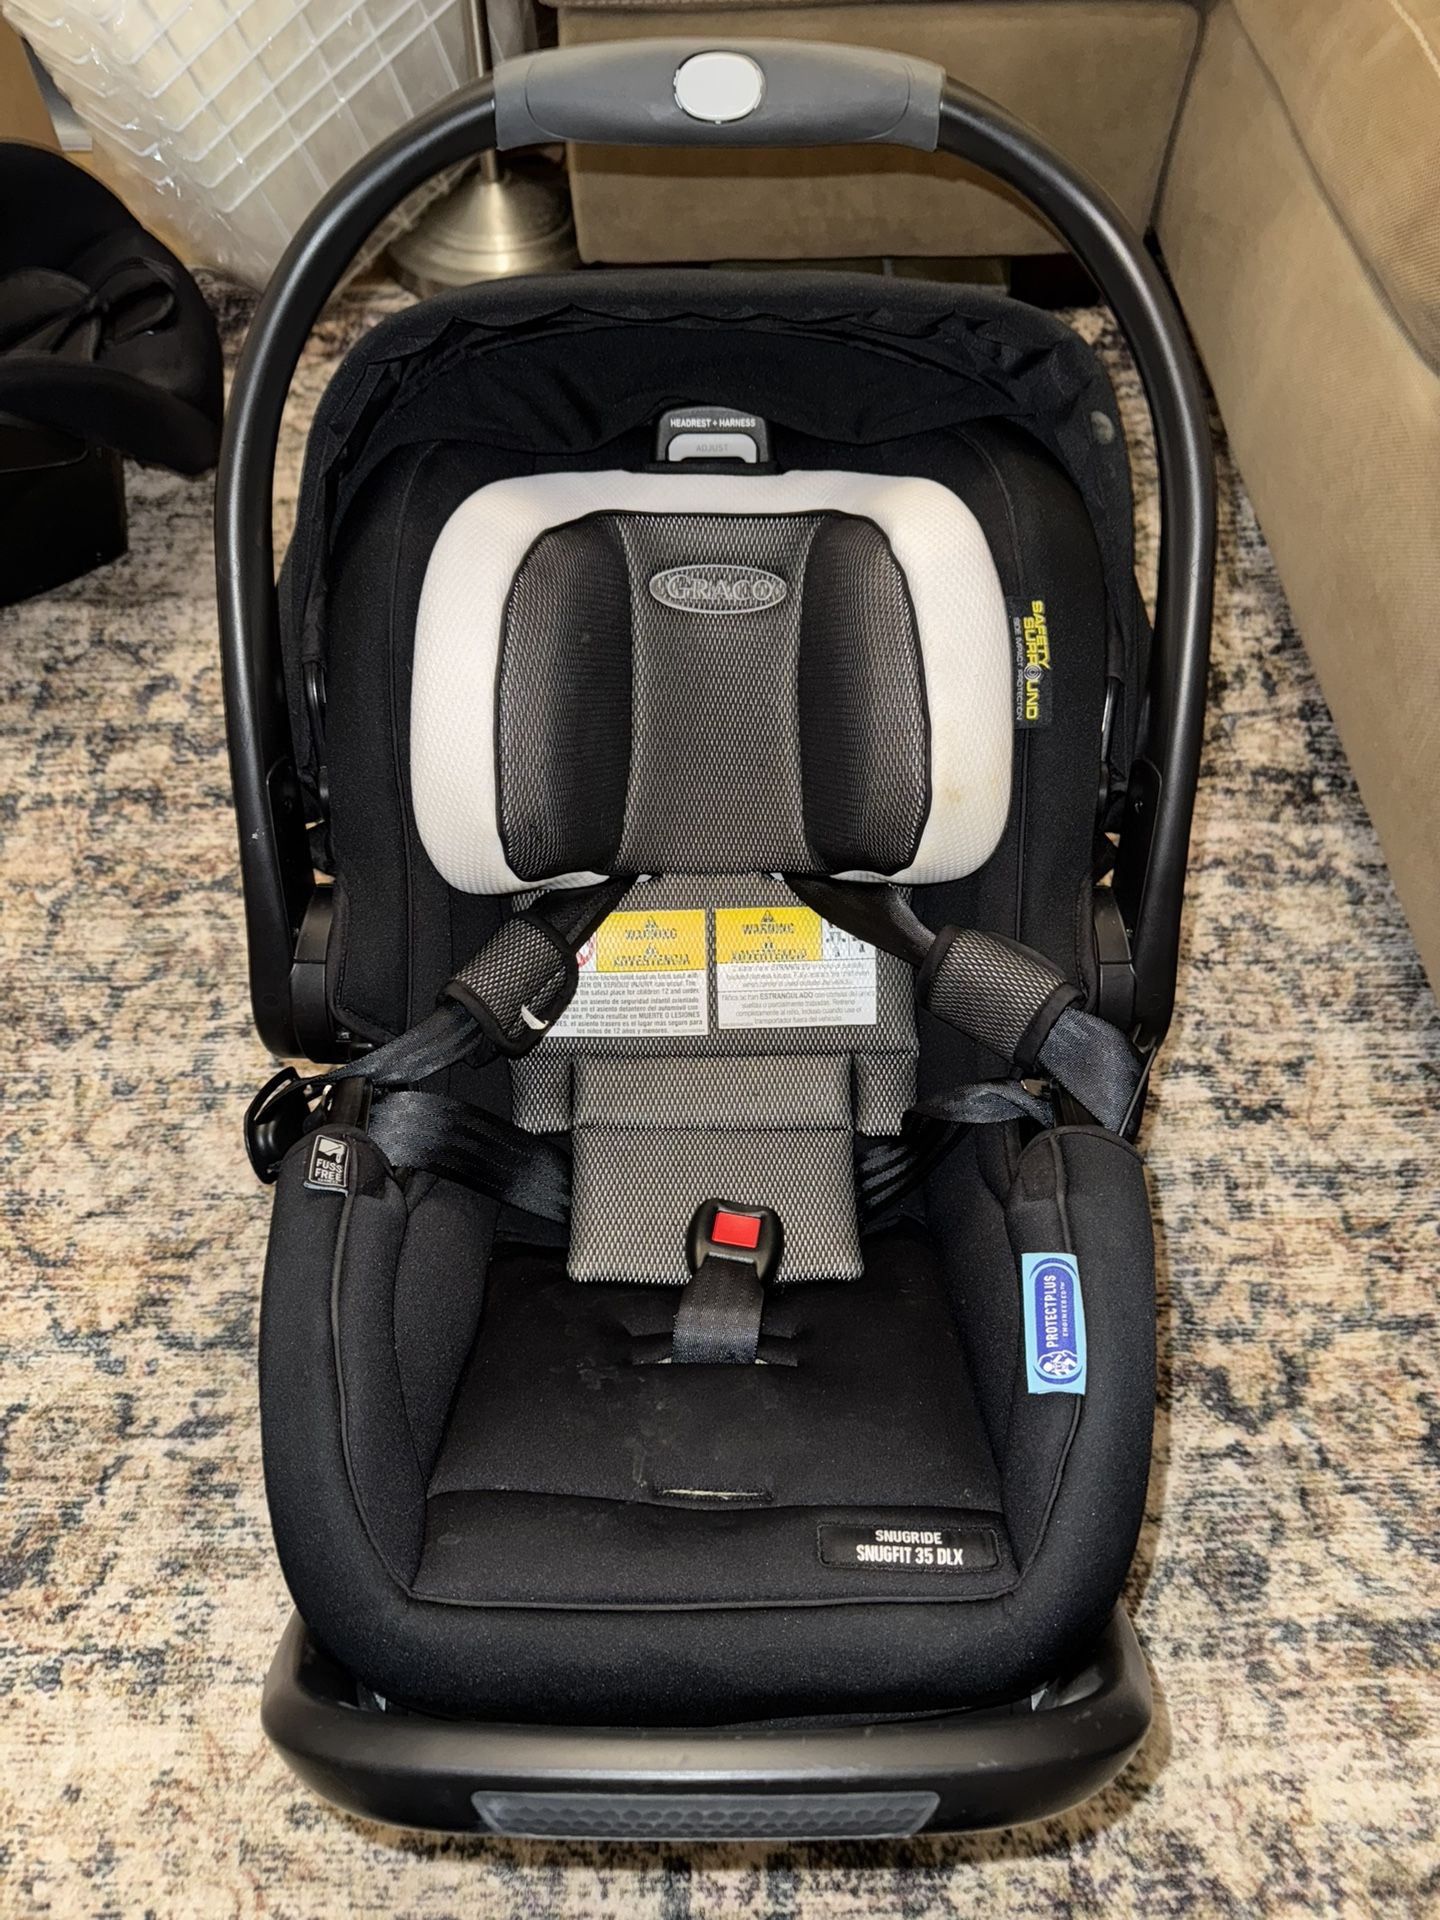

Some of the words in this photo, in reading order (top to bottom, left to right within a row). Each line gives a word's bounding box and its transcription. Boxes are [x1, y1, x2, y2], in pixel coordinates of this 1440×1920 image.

[670, 418, 711, 428] HEADREST
[719, 418, 756, 428] HARNESS
[696, 444, 729, 452] ADJUST
[667, 574, 773, 601] GRACO
[1031, 600, 1051, 670] SAFETY
[1014, 637, 1023, 667] IMPACT
[1015, 669, 1023, 721] PROTECTION
[314, 1168, 342, 1182] FREE
[316, 1158, 342, 1173] FUSS
[1043, 1275, 1059, 1348] PROTECTPLUS
[875, 1529, 943, 1545] SNUGRIDE
[856, 1544, 912, 1564] SNUGFIT
[915, 1548, 933, 1564] 35
[936, 1548, 963, 1566] DLX
